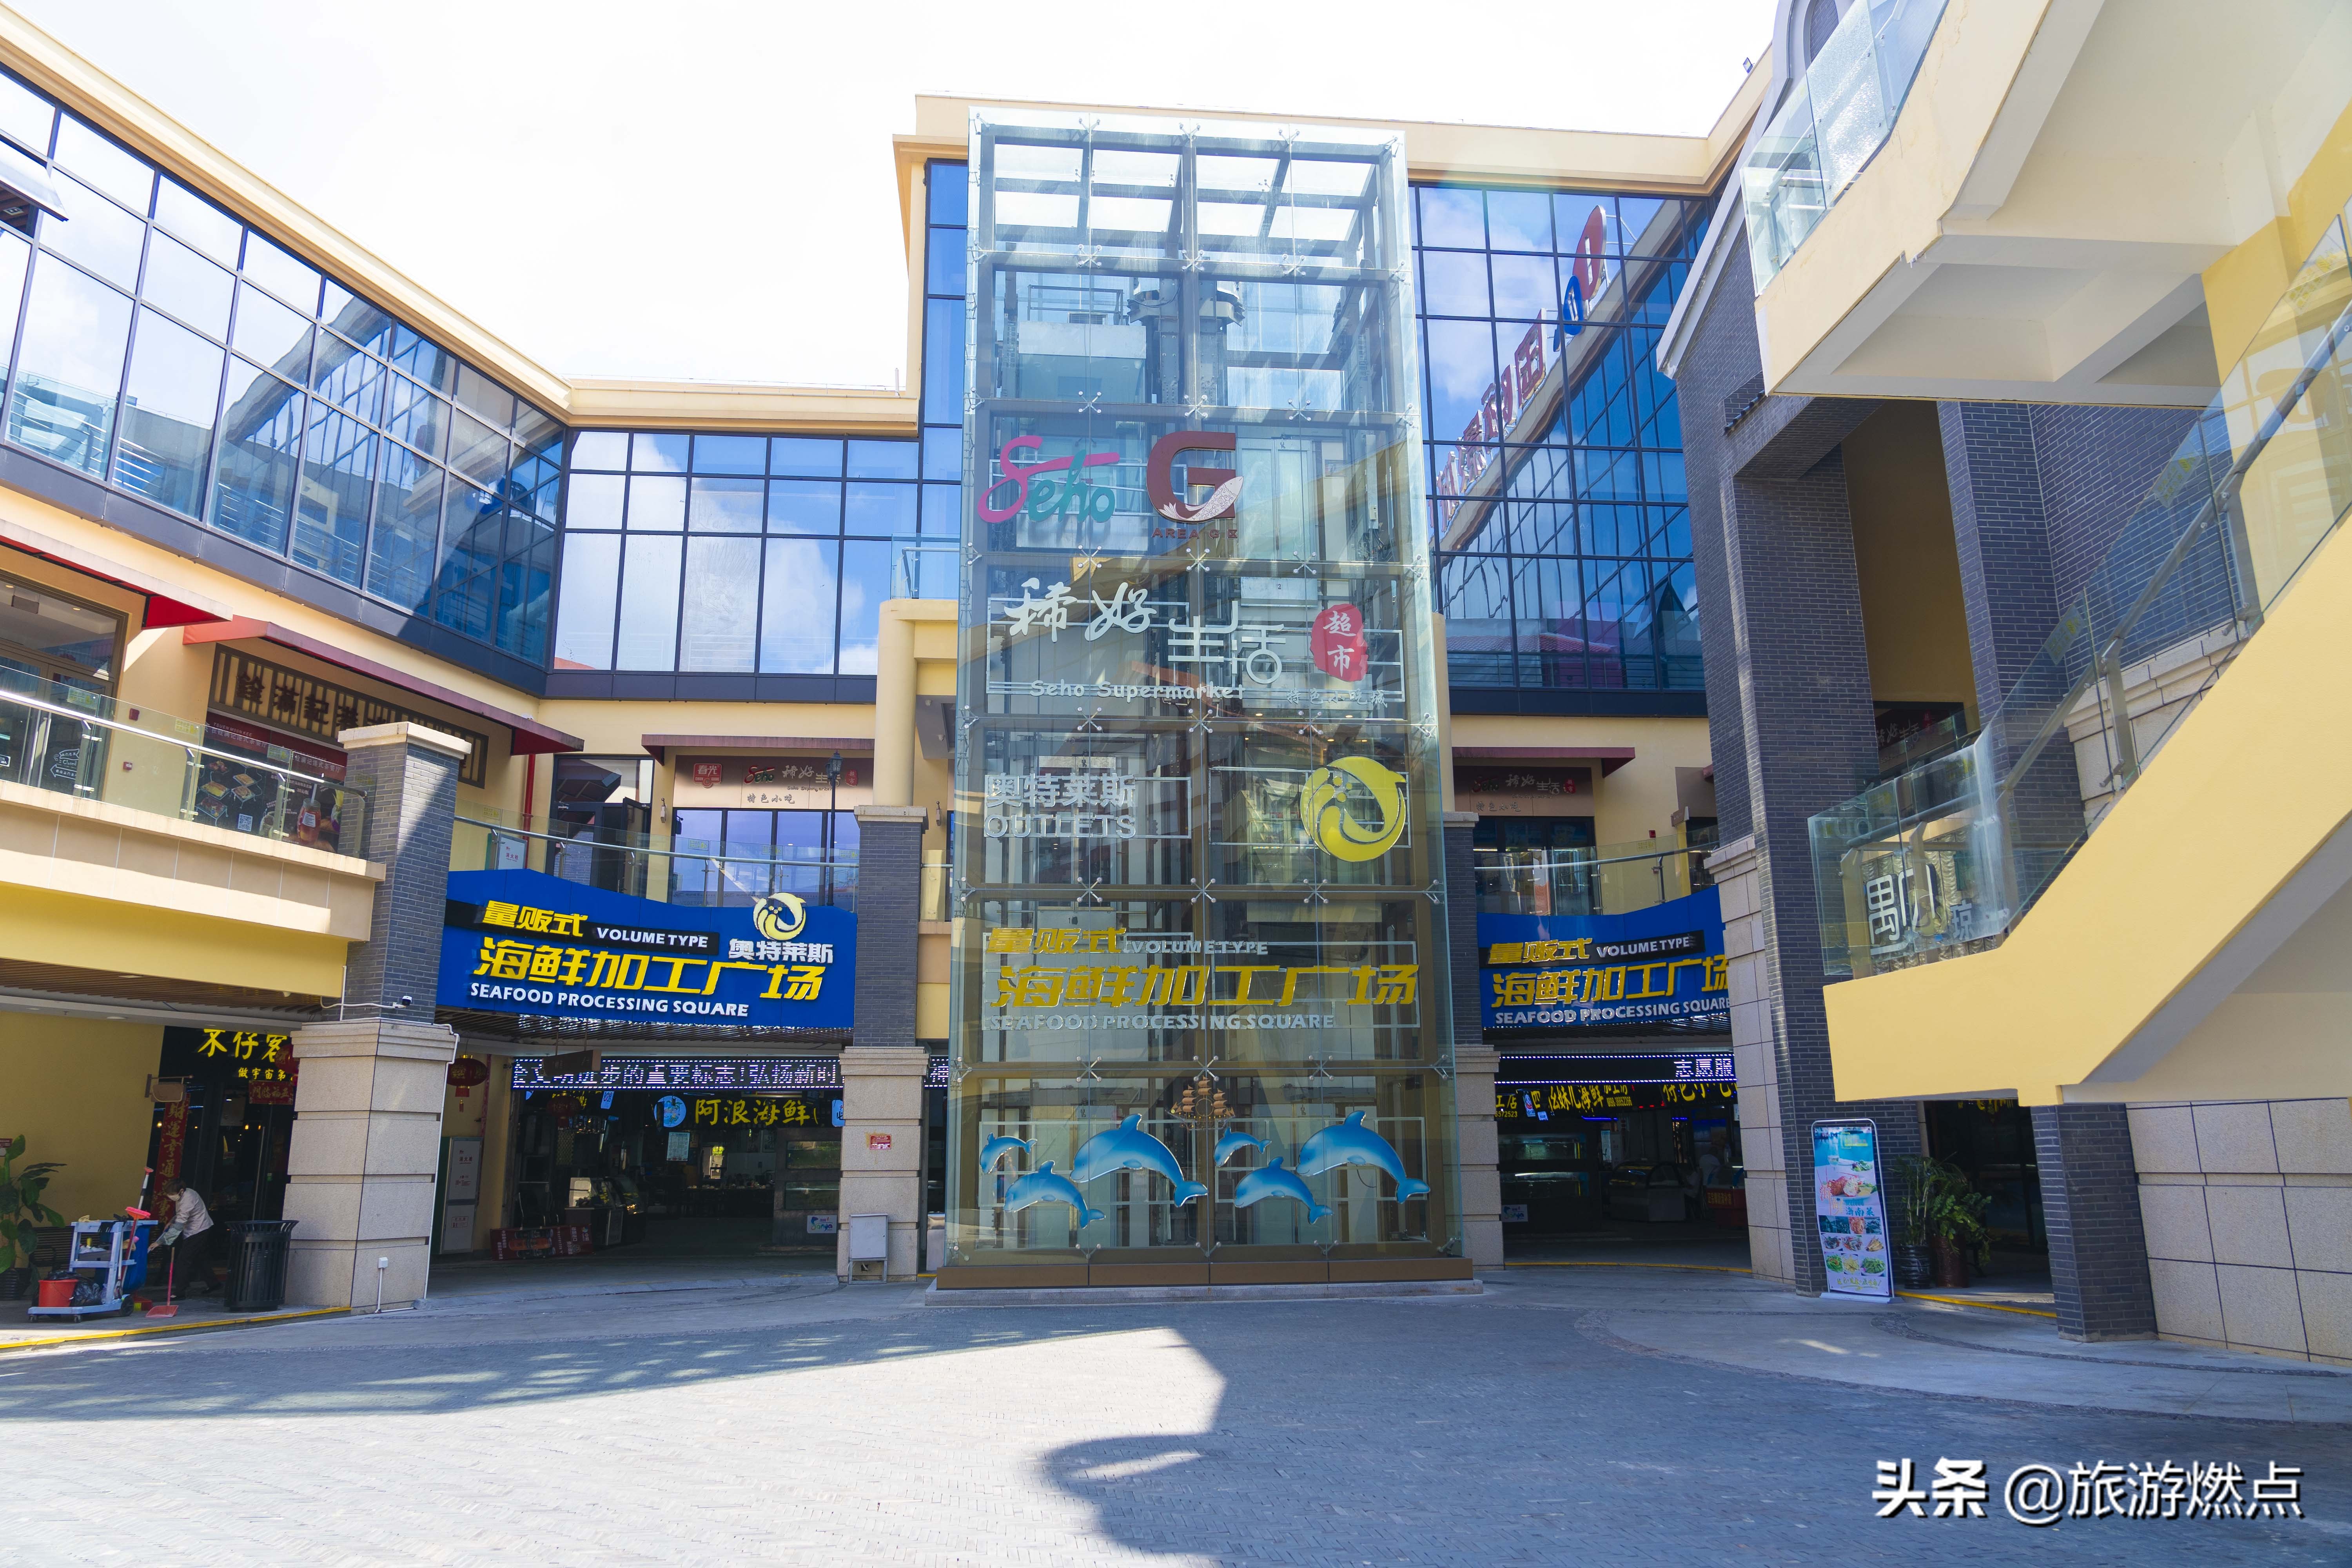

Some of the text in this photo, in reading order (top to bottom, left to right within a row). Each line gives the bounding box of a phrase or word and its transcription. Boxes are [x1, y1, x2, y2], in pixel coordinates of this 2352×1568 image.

[977, 436, 1120, 524] Seho
[1152, 527, 1239, 539] AREA G 区
[1323, 610, 1357, 675] 超市
[1031, 679, 1246, 703] Seho Supermarket
[1287, 687, 1388, 708] 特色小吃城
[697, 765, 717, 777] 春光
[744, 765, 775, 784] Seho
[747, 793, 795, 804] 特色小吃
[986, 773, 1136, 809] 奥特莱斯
[984, 813, 1137, 839] OUTLETS
[481, 900, 588, 937] 量贩式
[597, 927, 708, 949] VOLUME TYPE
[986, 927, 1127, 954] 量贩式
[1131, 940, 1269, 956] VOLUME TYPE
[1596, 936, 1690, 958] VOLUME TYPE
[728, 938, 834, 964] 奥特莱斯
[1488, 937, 1593, 965] 量贩式
[473, 937, 829, 1001] 海鲜加工广场
[990, 964, 1419, 1008] 海鲜加工广场
[470, 982, 749, 1018] SEAFOOD PROCESSING SQUARE
[988, 1014, 1335, 1030] SEAFOOD PROCESSING SQUARE
[1495, 1009, 1577, 1025] SEAFOOD
[1580, 1002, 1680, 1022] PROCESSING
[238, 1067, 294, 1081] 做宇宙第
[695, 1099, 810, 1126] 阿浪海鲜
[1846, 1207, 1875, 1216] 海南菜
